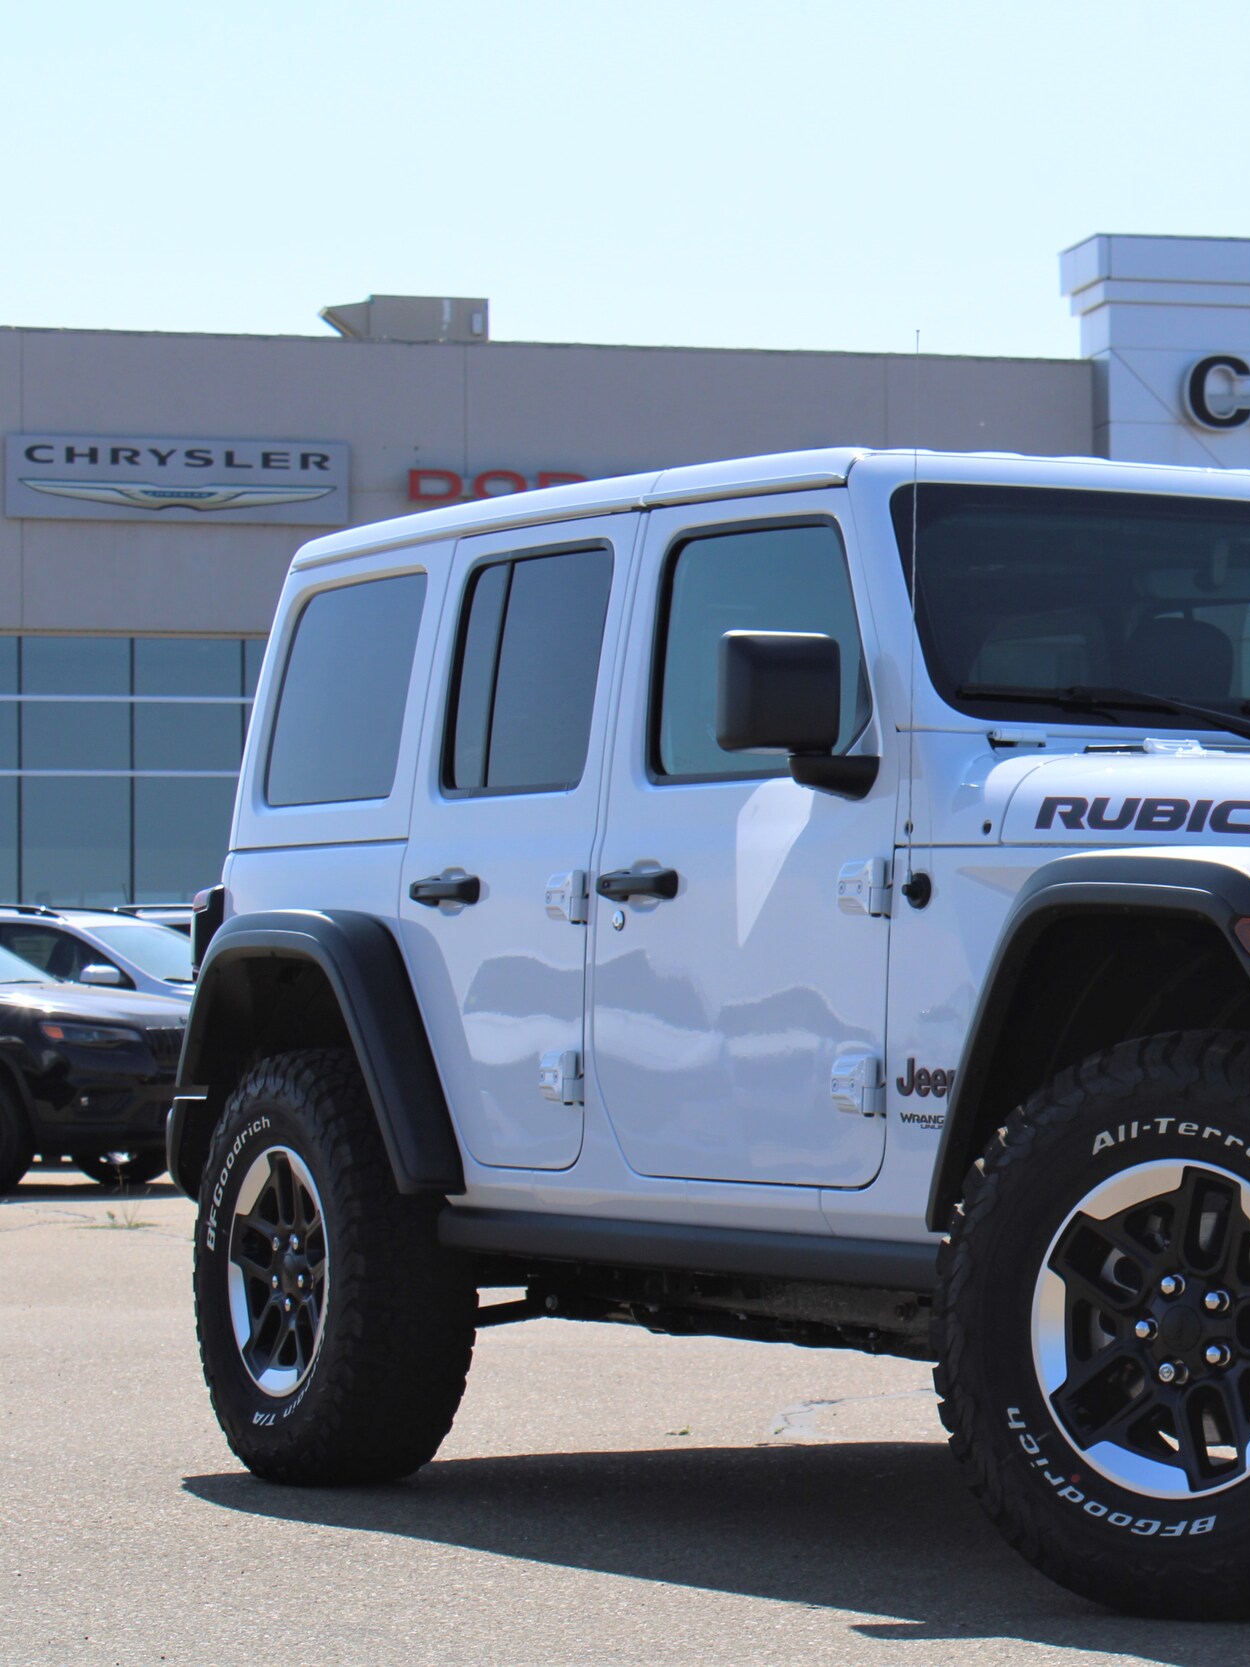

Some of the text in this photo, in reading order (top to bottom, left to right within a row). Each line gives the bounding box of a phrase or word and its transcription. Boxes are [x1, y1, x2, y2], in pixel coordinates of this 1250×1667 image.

[24, 444, 331, 471] CHRYSLER
[206, 1115, 271, 1252] BFGoodrich
[252, 1411, 276, 1427] T/A
[1006, 1406, 1218, 1537] BFGoodrich
